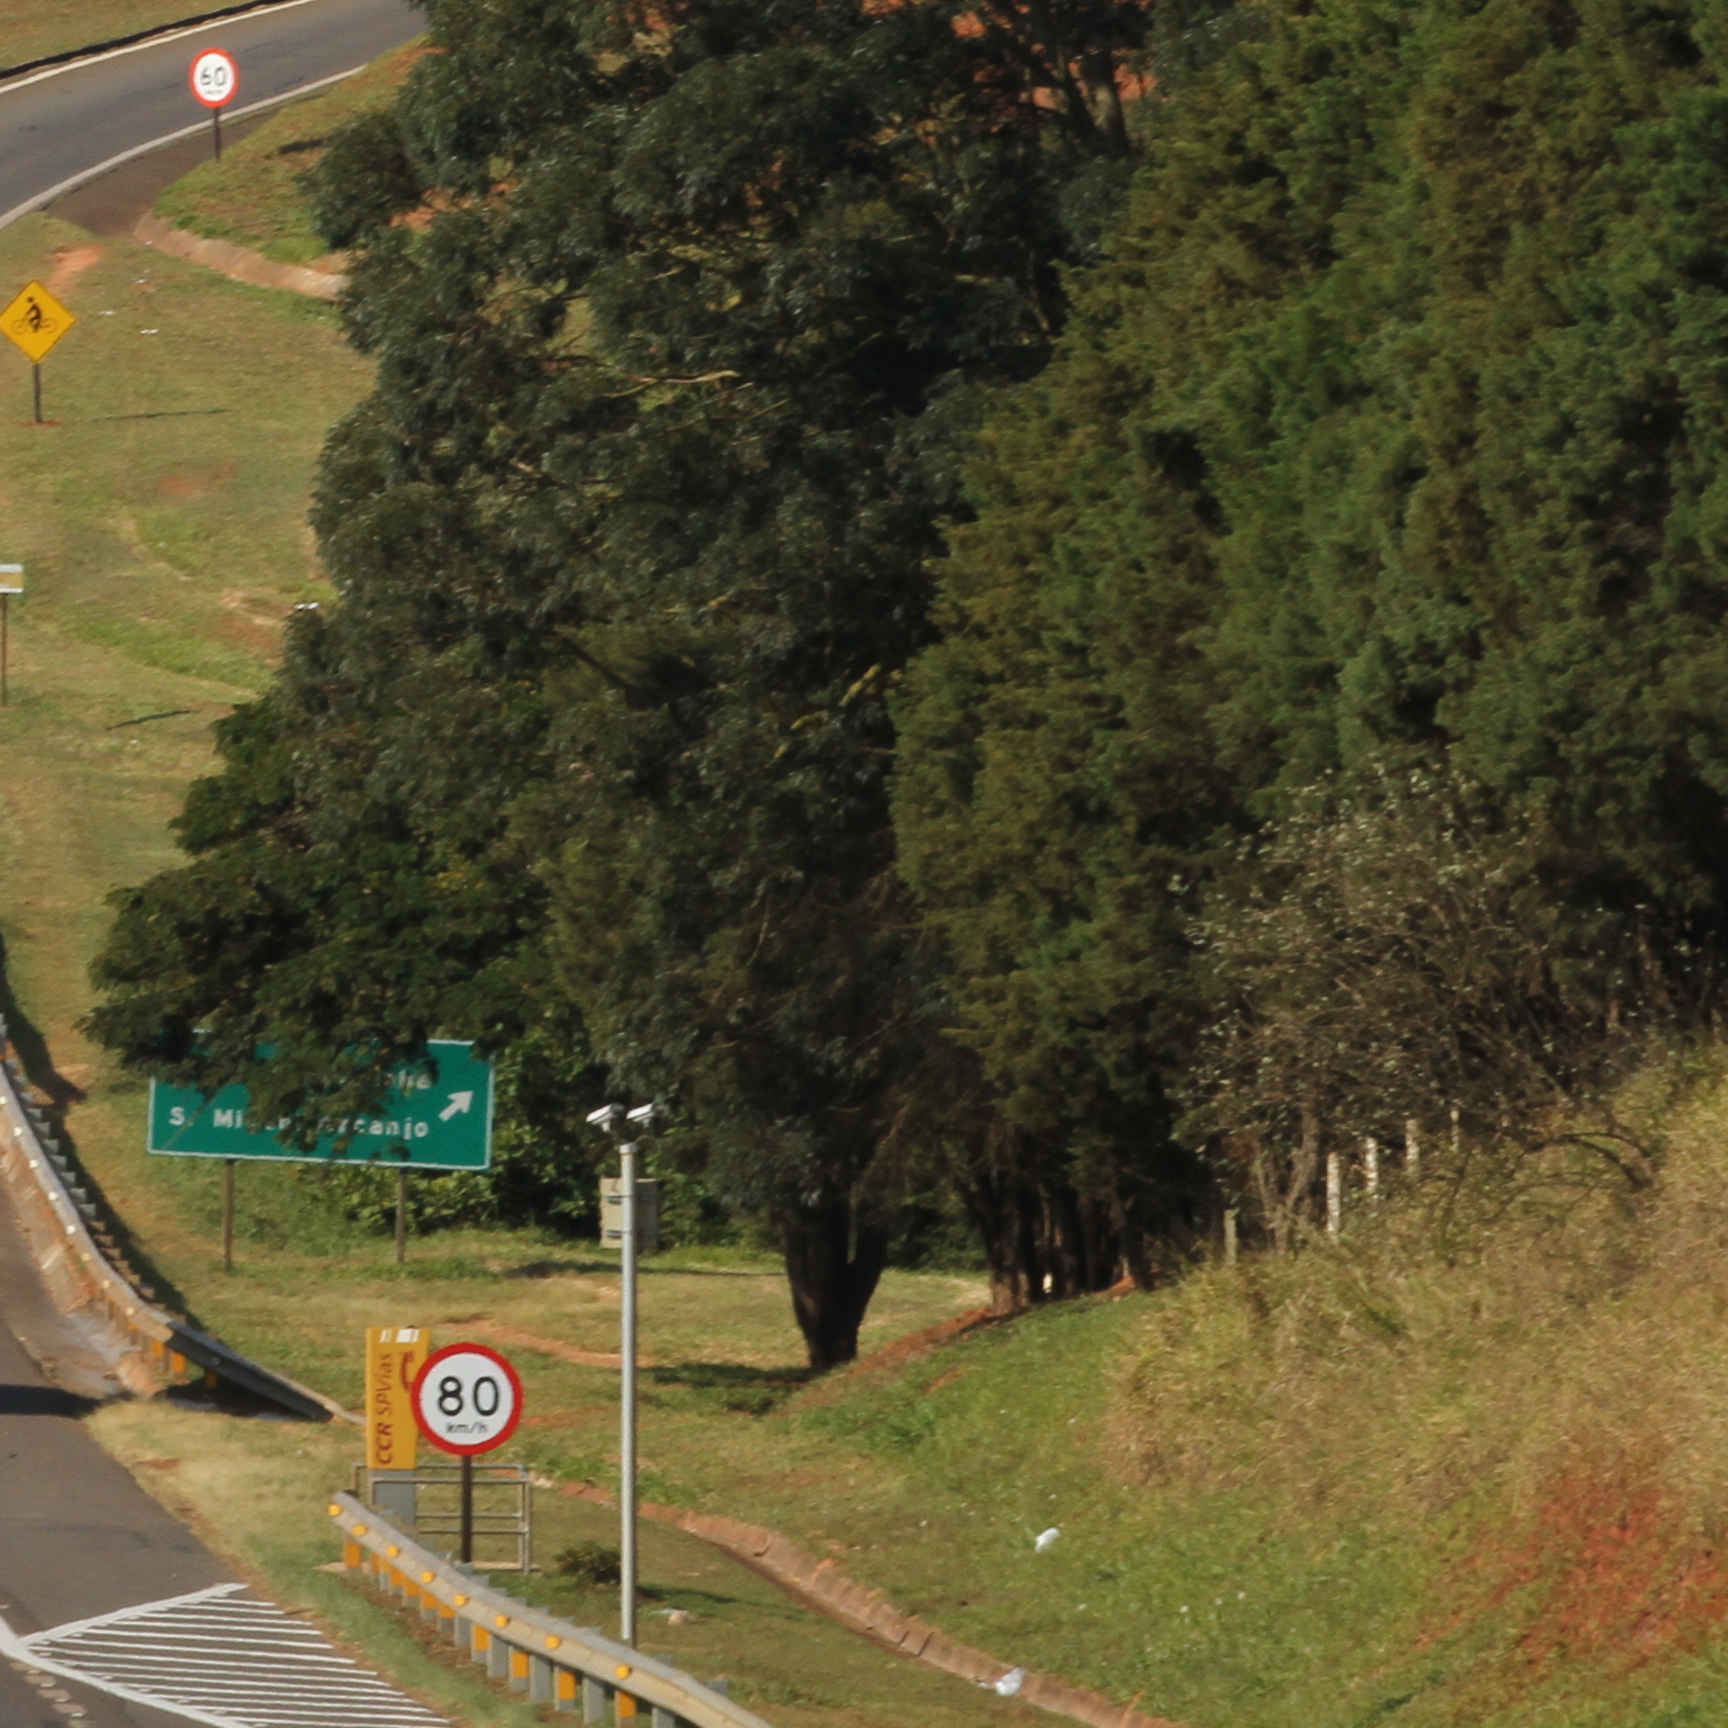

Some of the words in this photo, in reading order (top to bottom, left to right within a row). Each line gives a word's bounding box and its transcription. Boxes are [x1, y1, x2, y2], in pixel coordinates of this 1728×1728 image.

[200, 65, 228, 87] 60
[437, 1375, 500, 1417] 80
[445, 1420, 489, 1434] km/h
[376, 1422, 393, 1465] CCR
